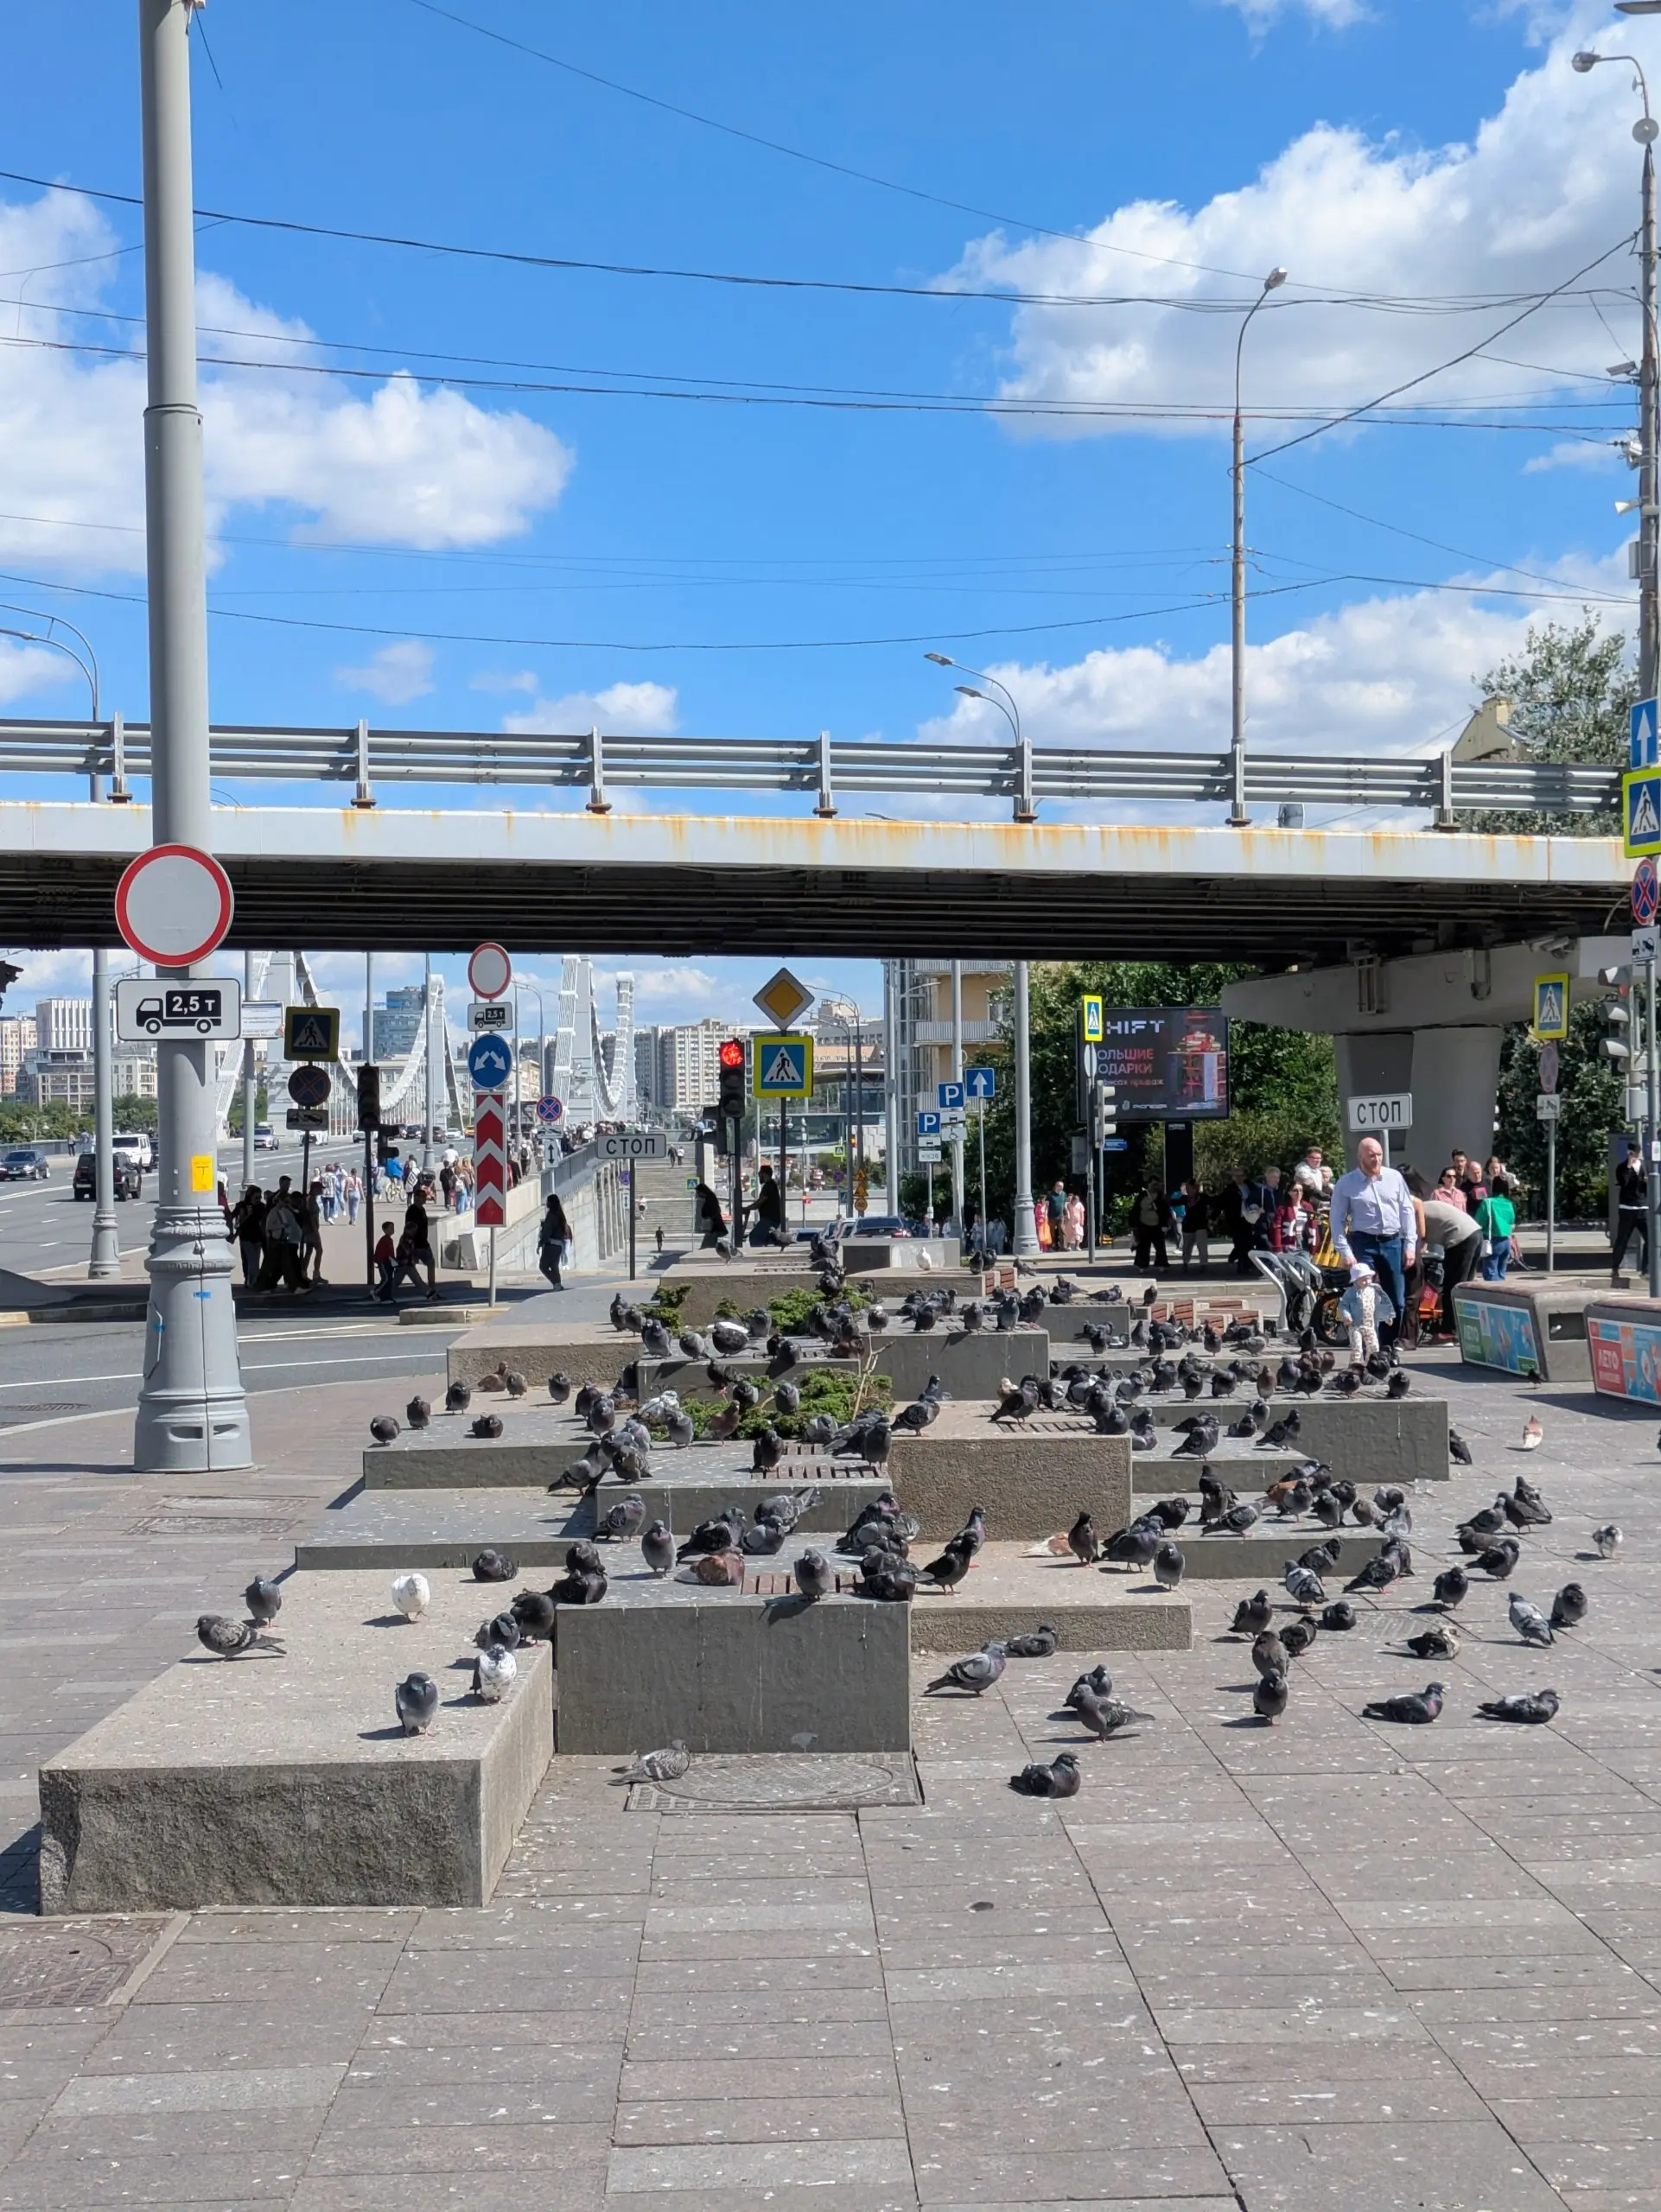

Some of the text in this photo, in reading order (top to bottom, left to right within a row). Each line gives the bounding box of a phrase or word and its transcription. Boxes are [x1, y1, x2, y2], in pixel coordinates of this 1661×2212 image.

[172, 995, 200, 1014] 2,5
[1102, 1020, 1165, 1034] HIFT
[1096, 1048, 1155, 1060] ОЛЬШИЕ
[1098, 1063, 1153, 1076] ОДАРКИ
[945, 1085, 959, 1106] P
[1357, 1101, 1401, 1125] СТОП
[924, 1114, 937, 1132] P
[606, 1138, 655, 1155] СТОП
